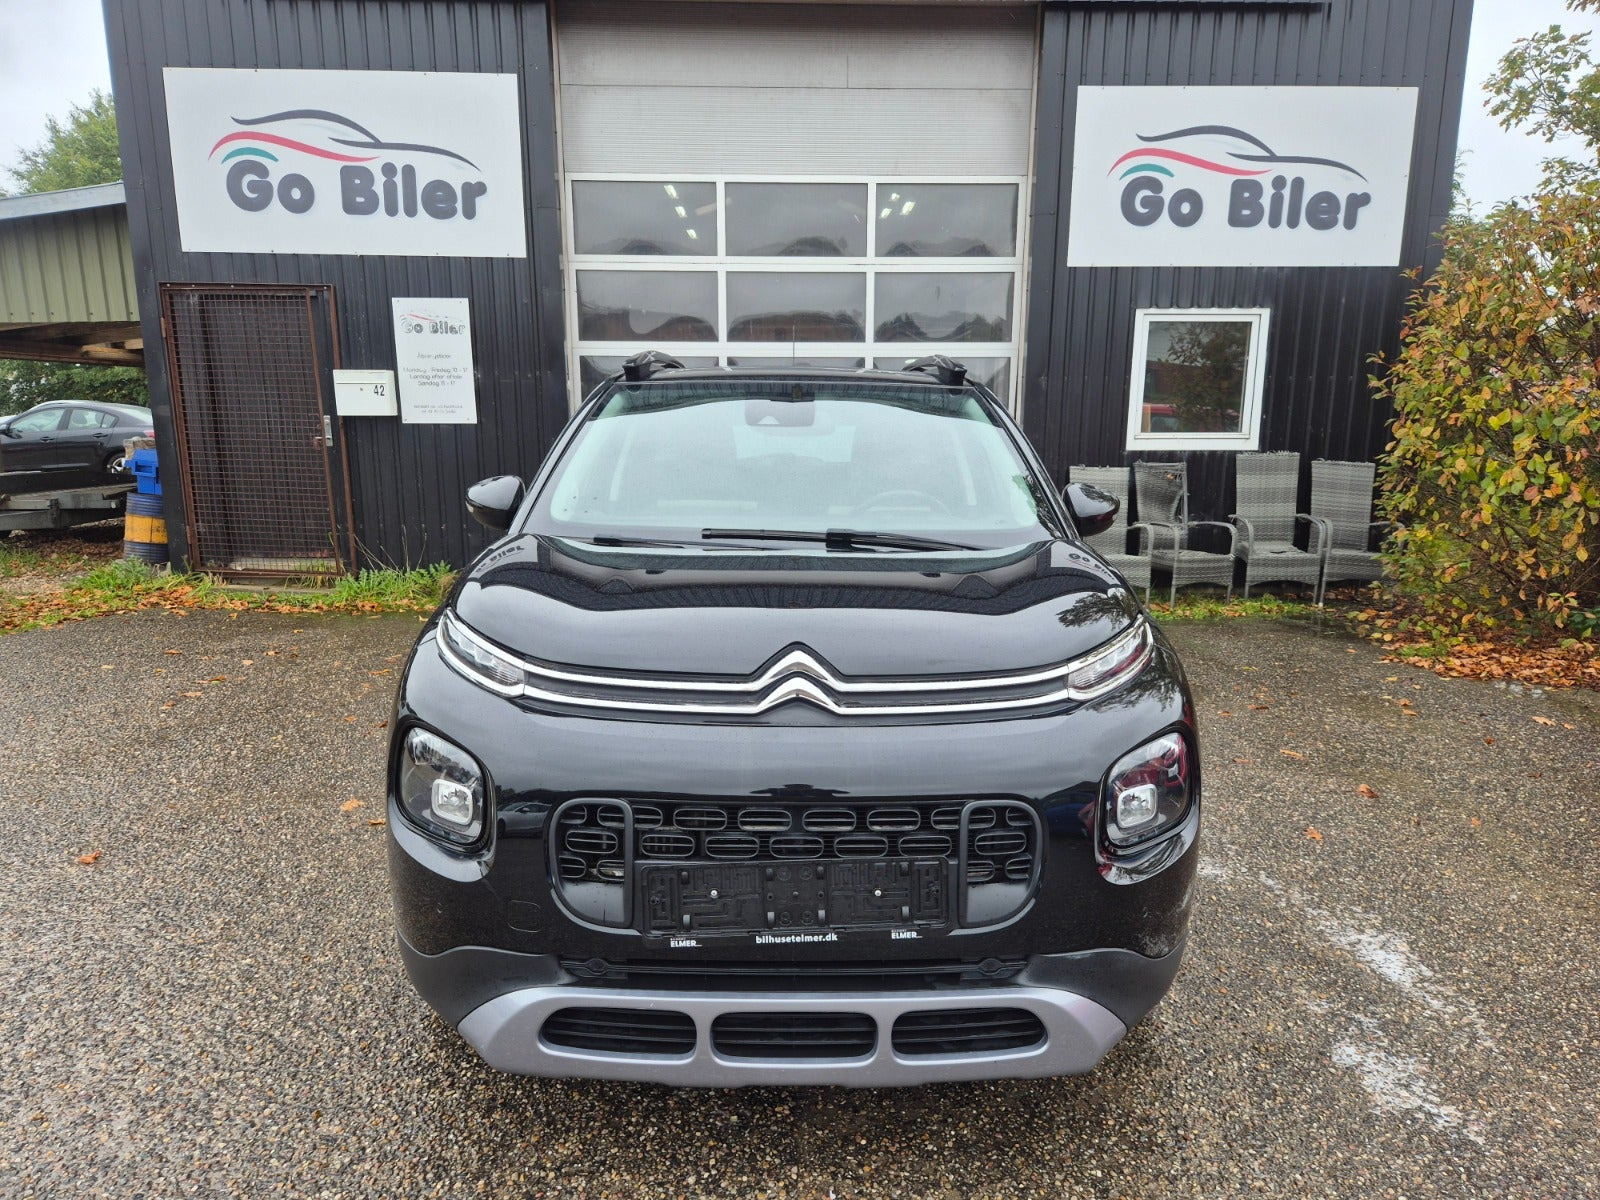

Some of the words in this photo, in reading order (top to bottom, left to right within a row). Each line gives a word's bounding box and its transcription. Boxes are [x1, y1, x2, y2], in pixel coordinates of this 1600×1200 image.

[226, 159, 315, 214] Go
[340, 161, 488, 221] Biler
[1120, 175, 1204, 228] Go
[1227, 174, 1372, 231] Biler
[429, 320, 466, 335] Biler
[373, 384, 385, 397] 42
[755, 932, 838, 944] bilhusetelmer.dk
[891, 931, 918, 939] ELMER
[670, 939, 698, 948] ELMER
